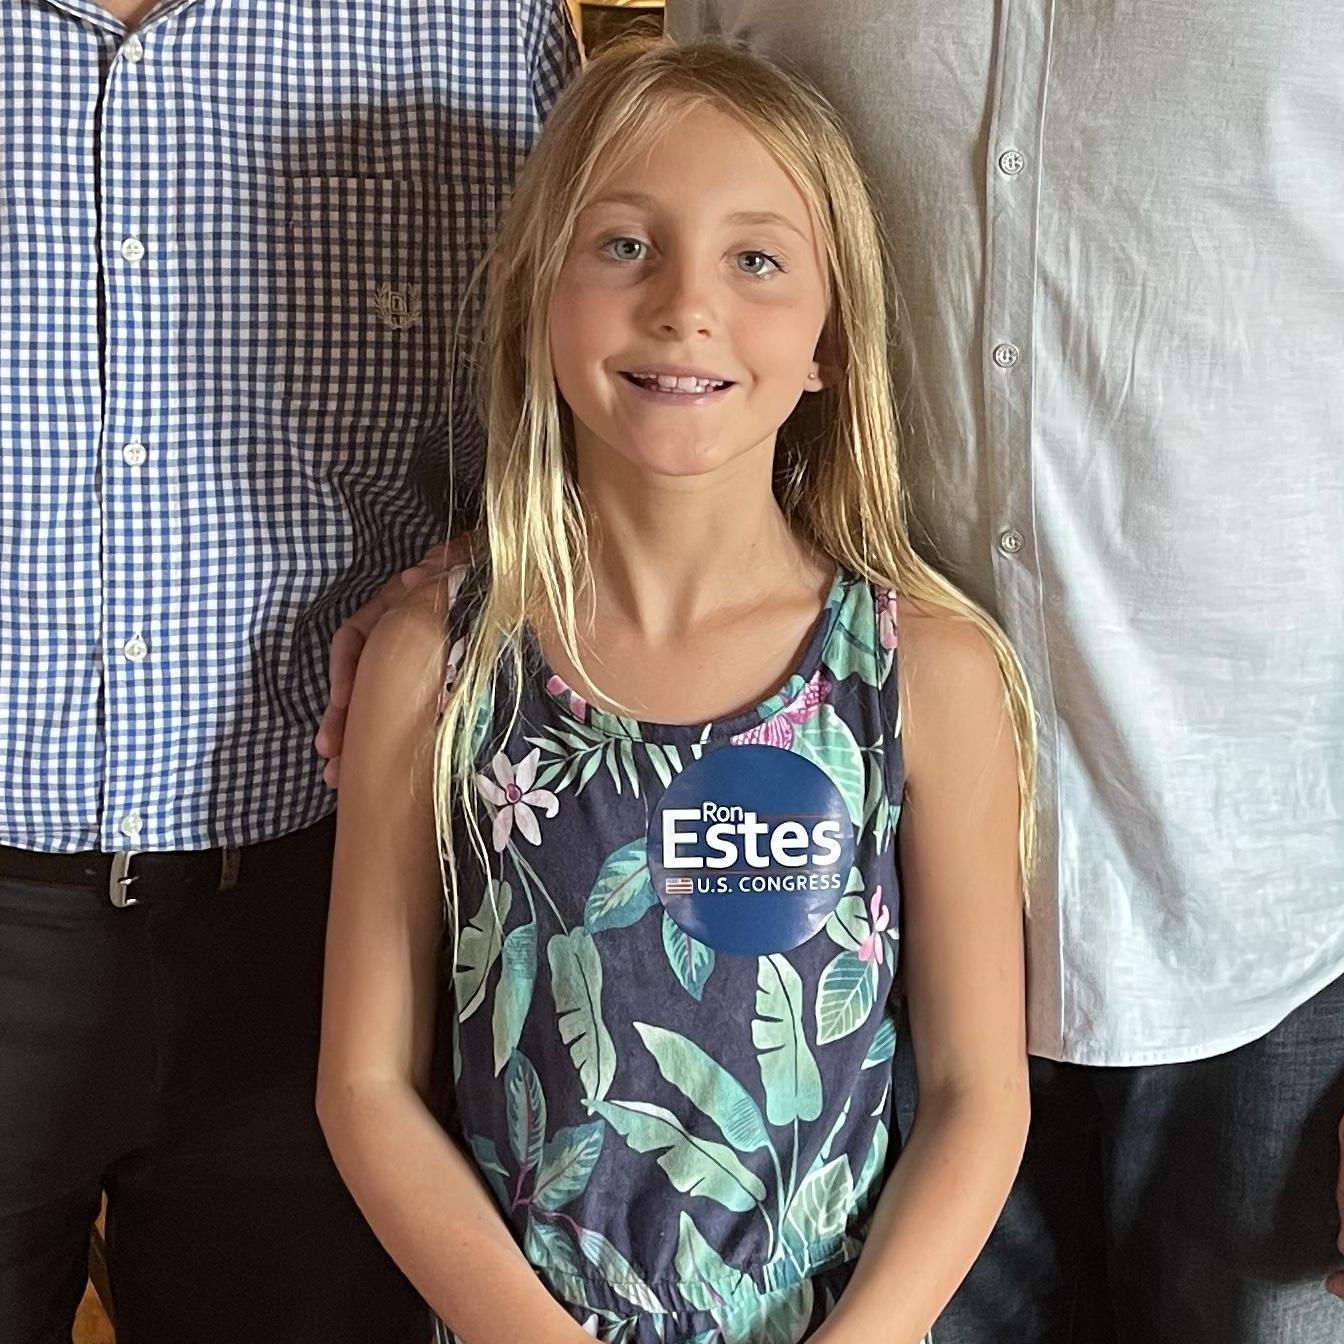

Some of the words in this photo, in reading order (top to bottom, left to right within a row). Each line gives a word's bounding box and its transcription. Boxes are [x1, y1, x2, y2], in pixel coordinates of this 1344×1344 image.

[703, 801, 743, 822] Ron
[662, 809, 842, 869] Estes
[697, 877, 732, 893] U.S.
[738, 873, 842, 892] CONGRESS
